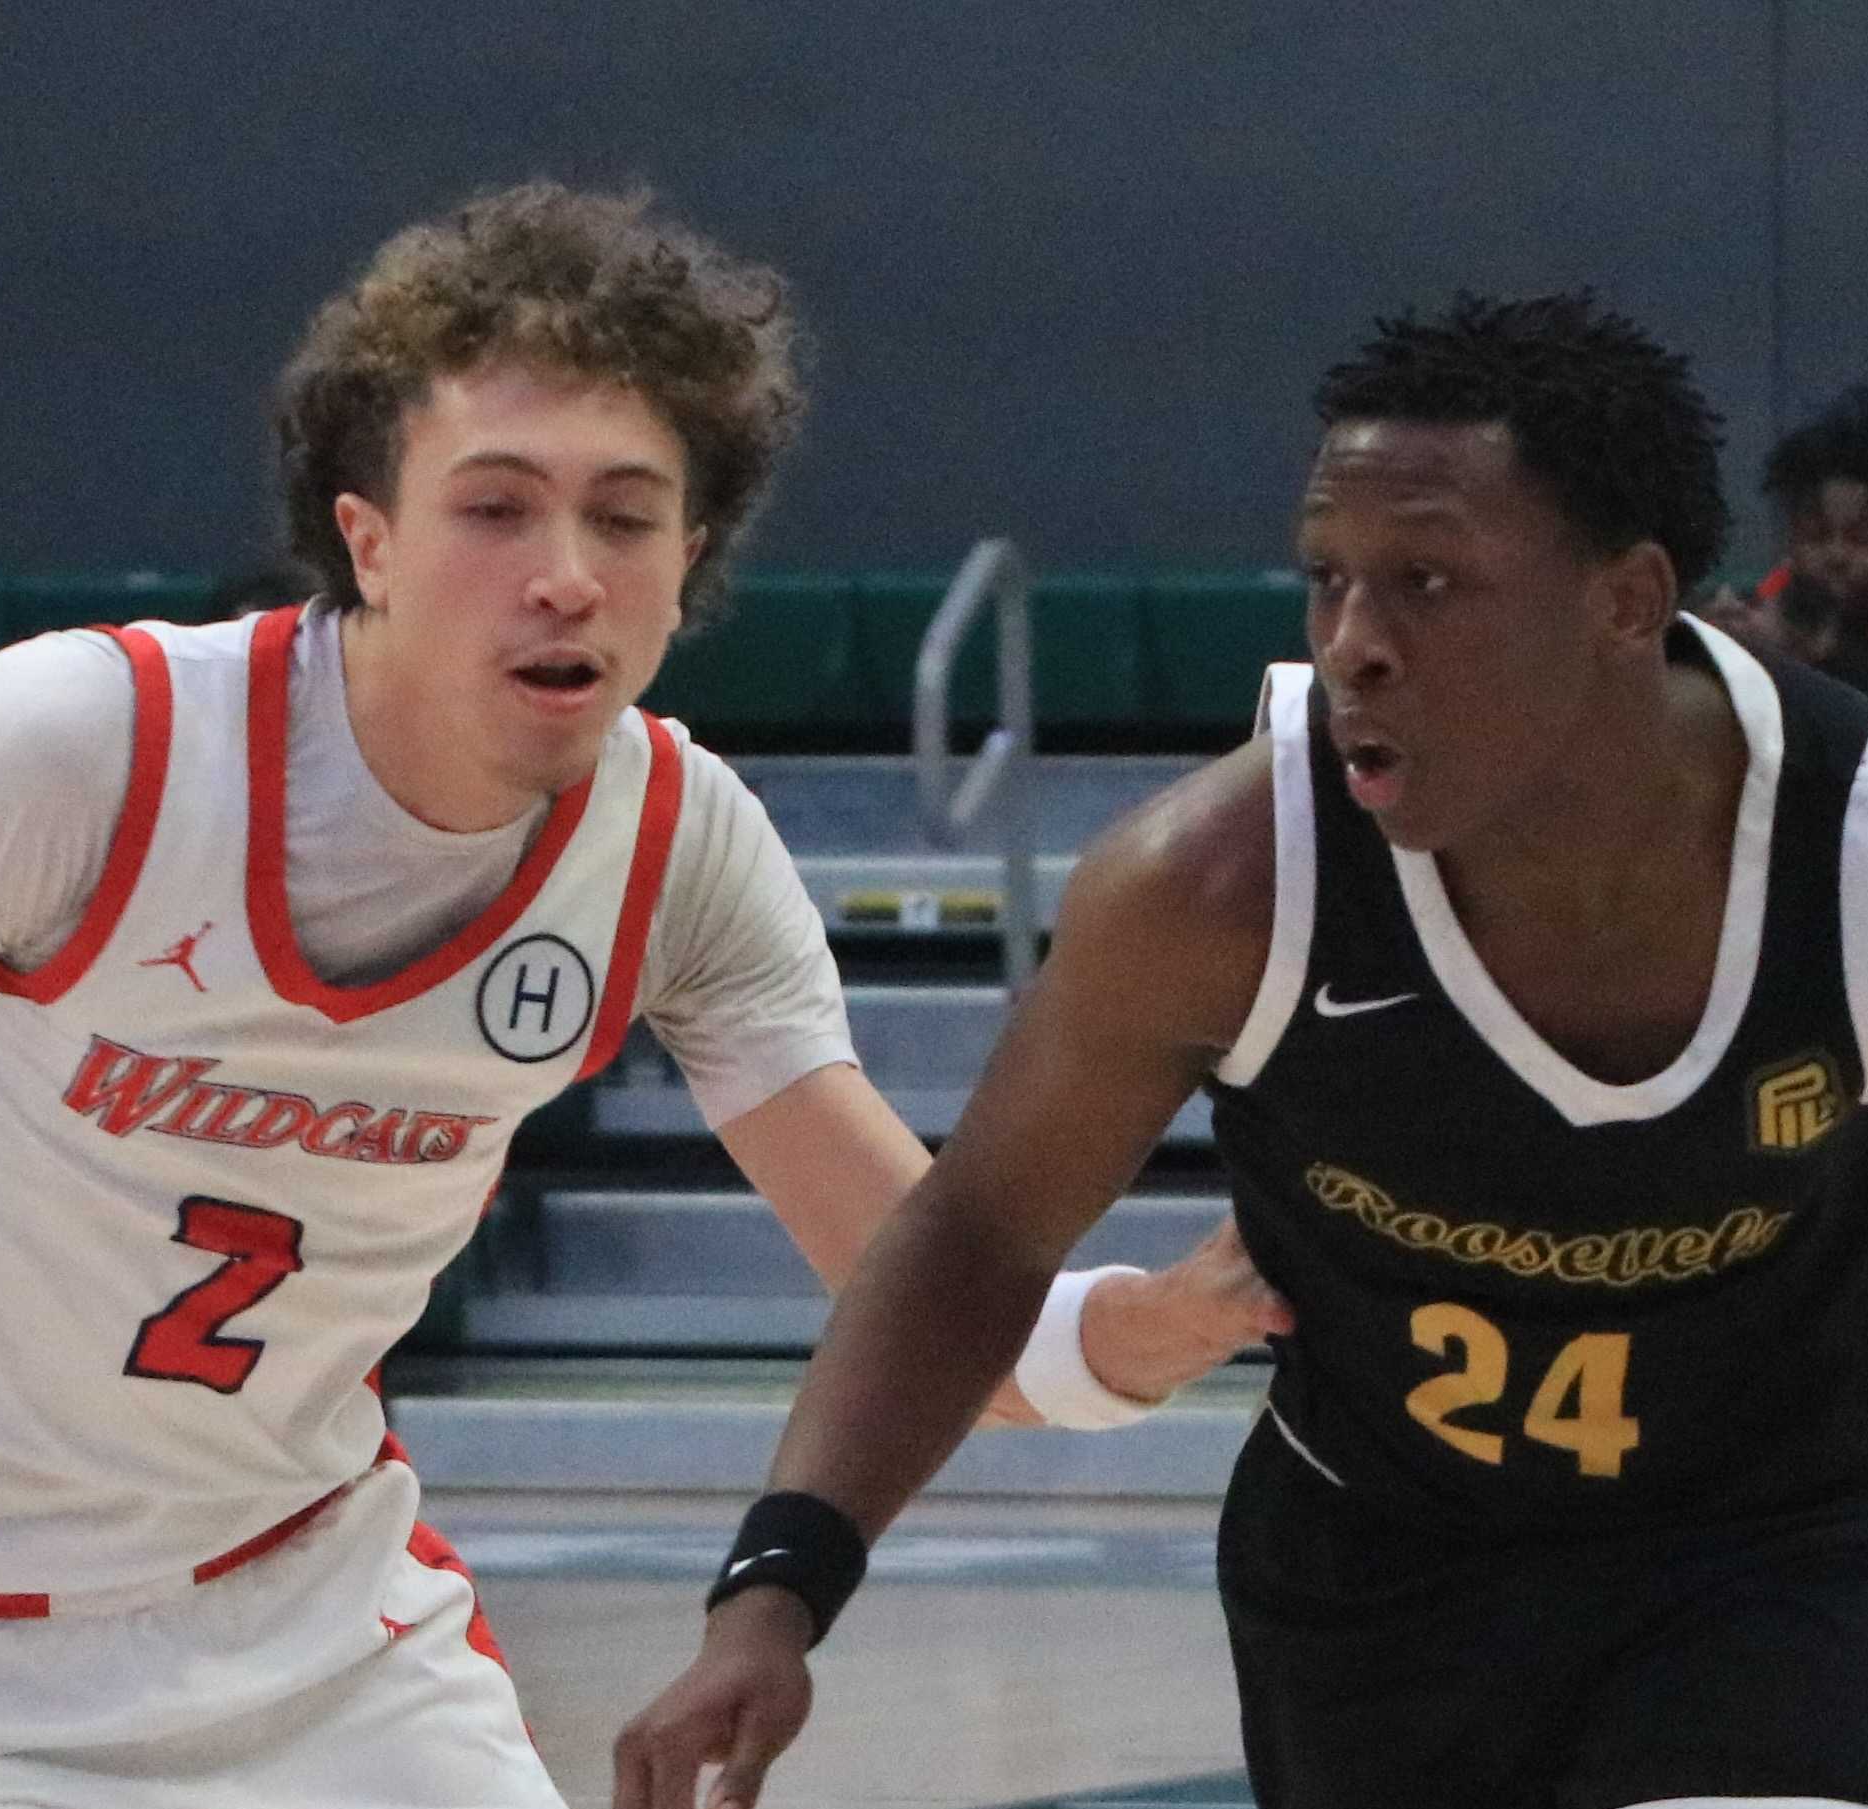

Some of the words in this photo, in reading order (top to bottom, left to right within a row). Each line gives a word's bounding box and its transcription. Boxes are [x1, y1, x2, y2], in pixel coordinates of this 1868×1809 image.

[508, 963, 560, 1033] H
[123, 1194, 304, 1395] 2
[1405, 1301, 1639, 1479] 24
